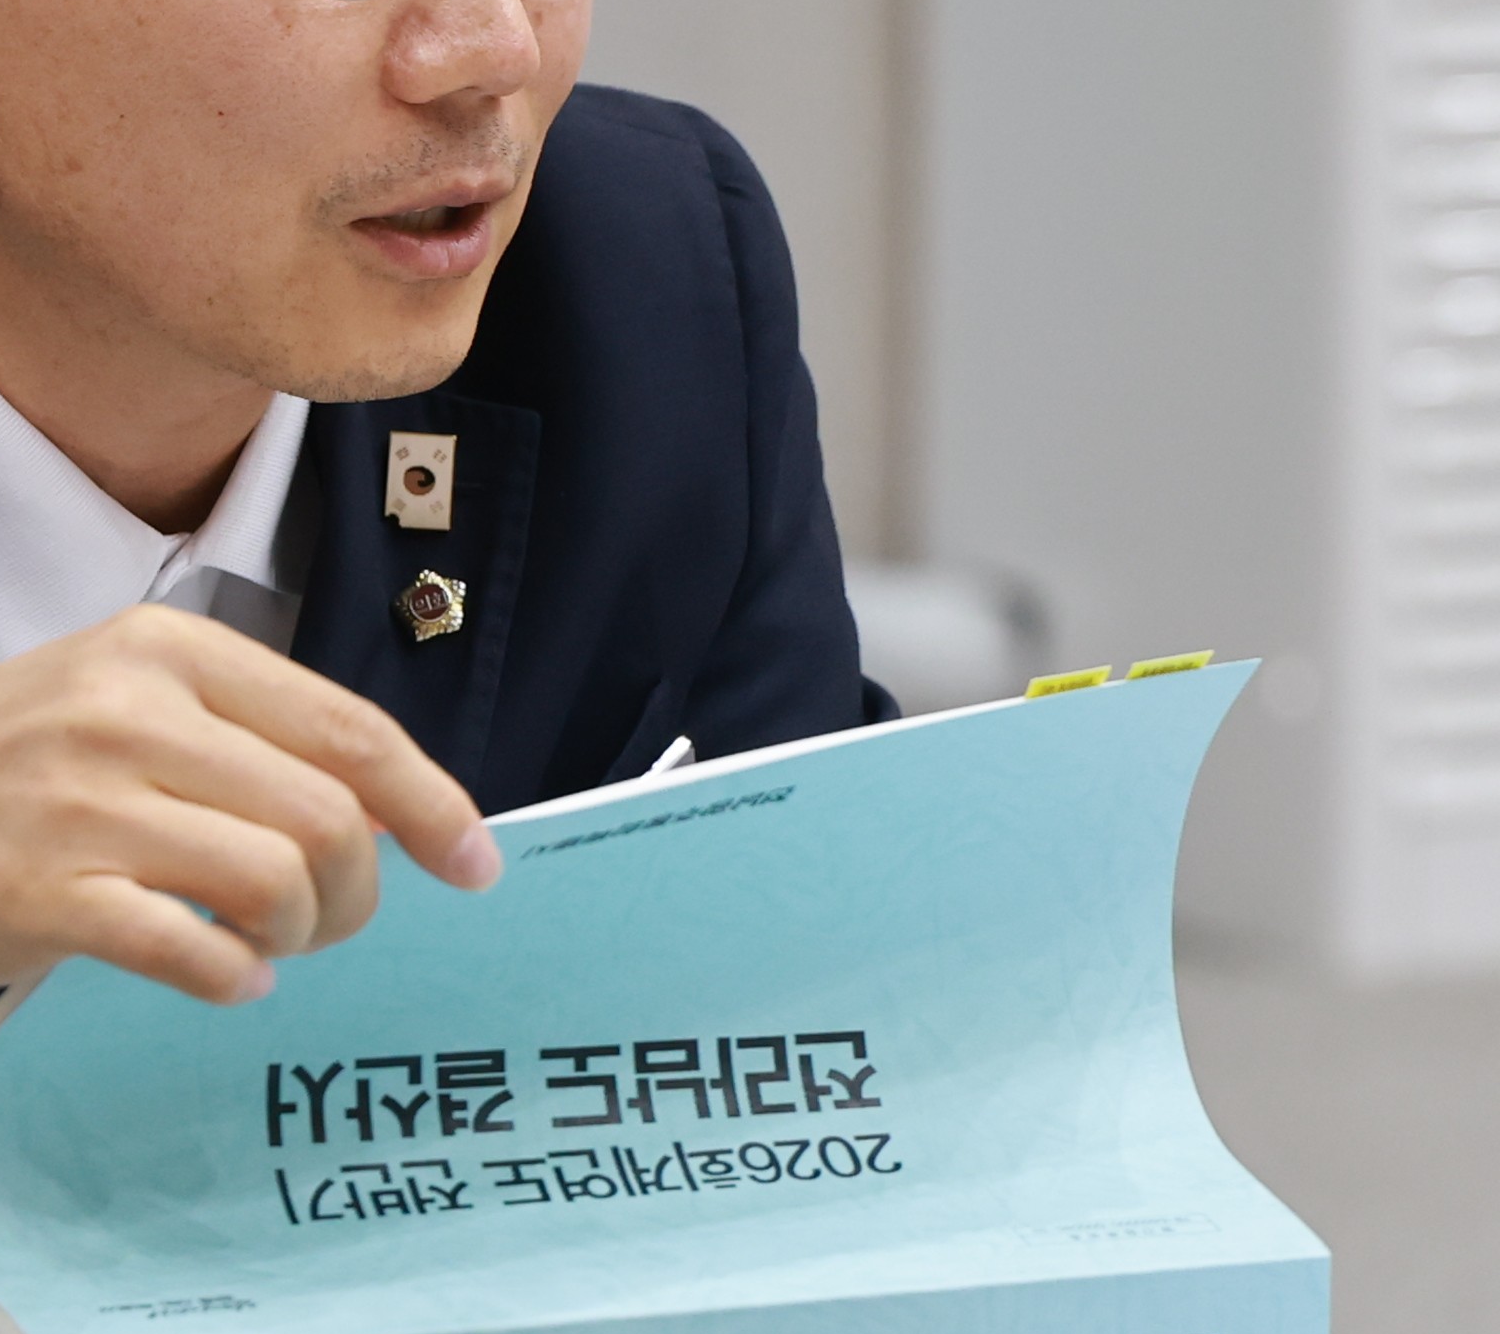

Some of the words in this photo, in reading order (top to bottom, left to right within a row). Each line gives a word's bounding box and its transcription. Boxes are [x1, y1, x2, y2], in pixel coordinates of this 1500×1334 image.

[264, 1047, 516, 1149] 결산서
[537, 1028, 883, 1130] 전라남도
[273, 1157, 475, 1227] 전반기
[479, 1131, 904, 1208] 2026회계연도
